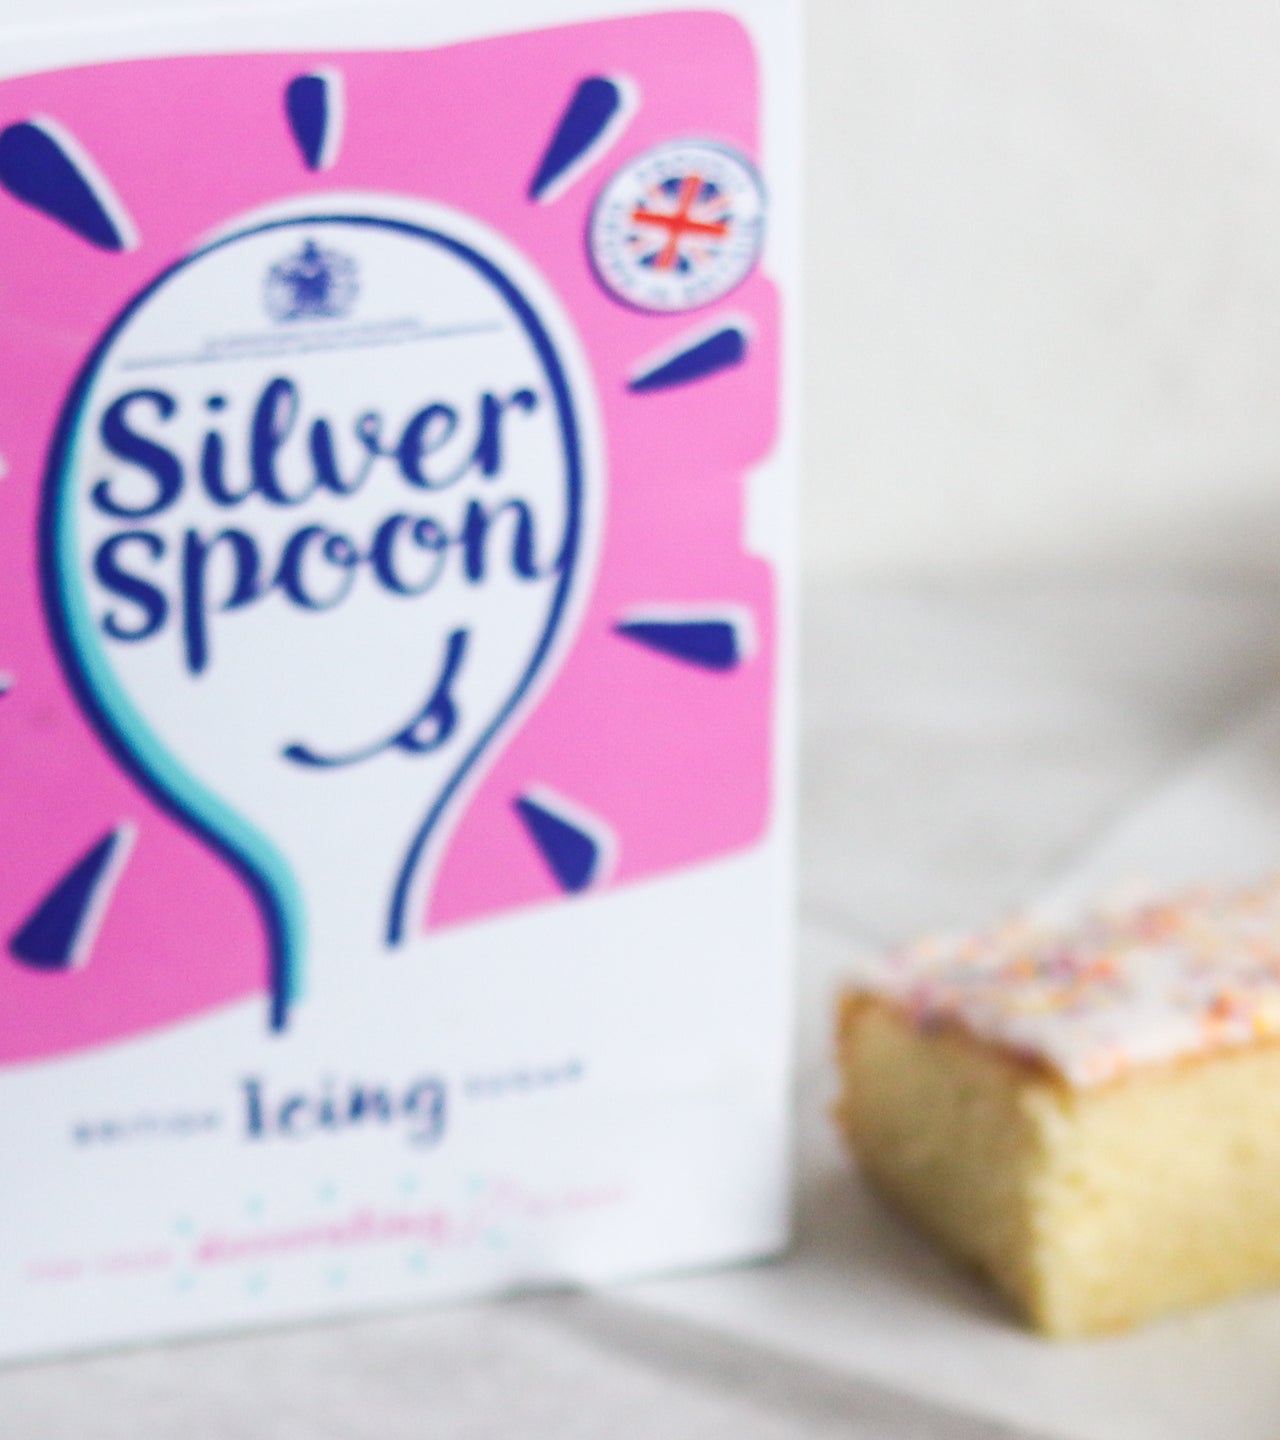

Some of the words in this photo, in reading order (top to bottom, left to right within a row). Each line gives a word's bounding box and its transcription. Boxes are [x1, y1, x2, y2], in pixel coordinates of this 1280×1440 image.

[90, 376, 538, 520] Silver
[92, 498, 558, 677] spoon
[240, 1073, 449, 1149] Icing
